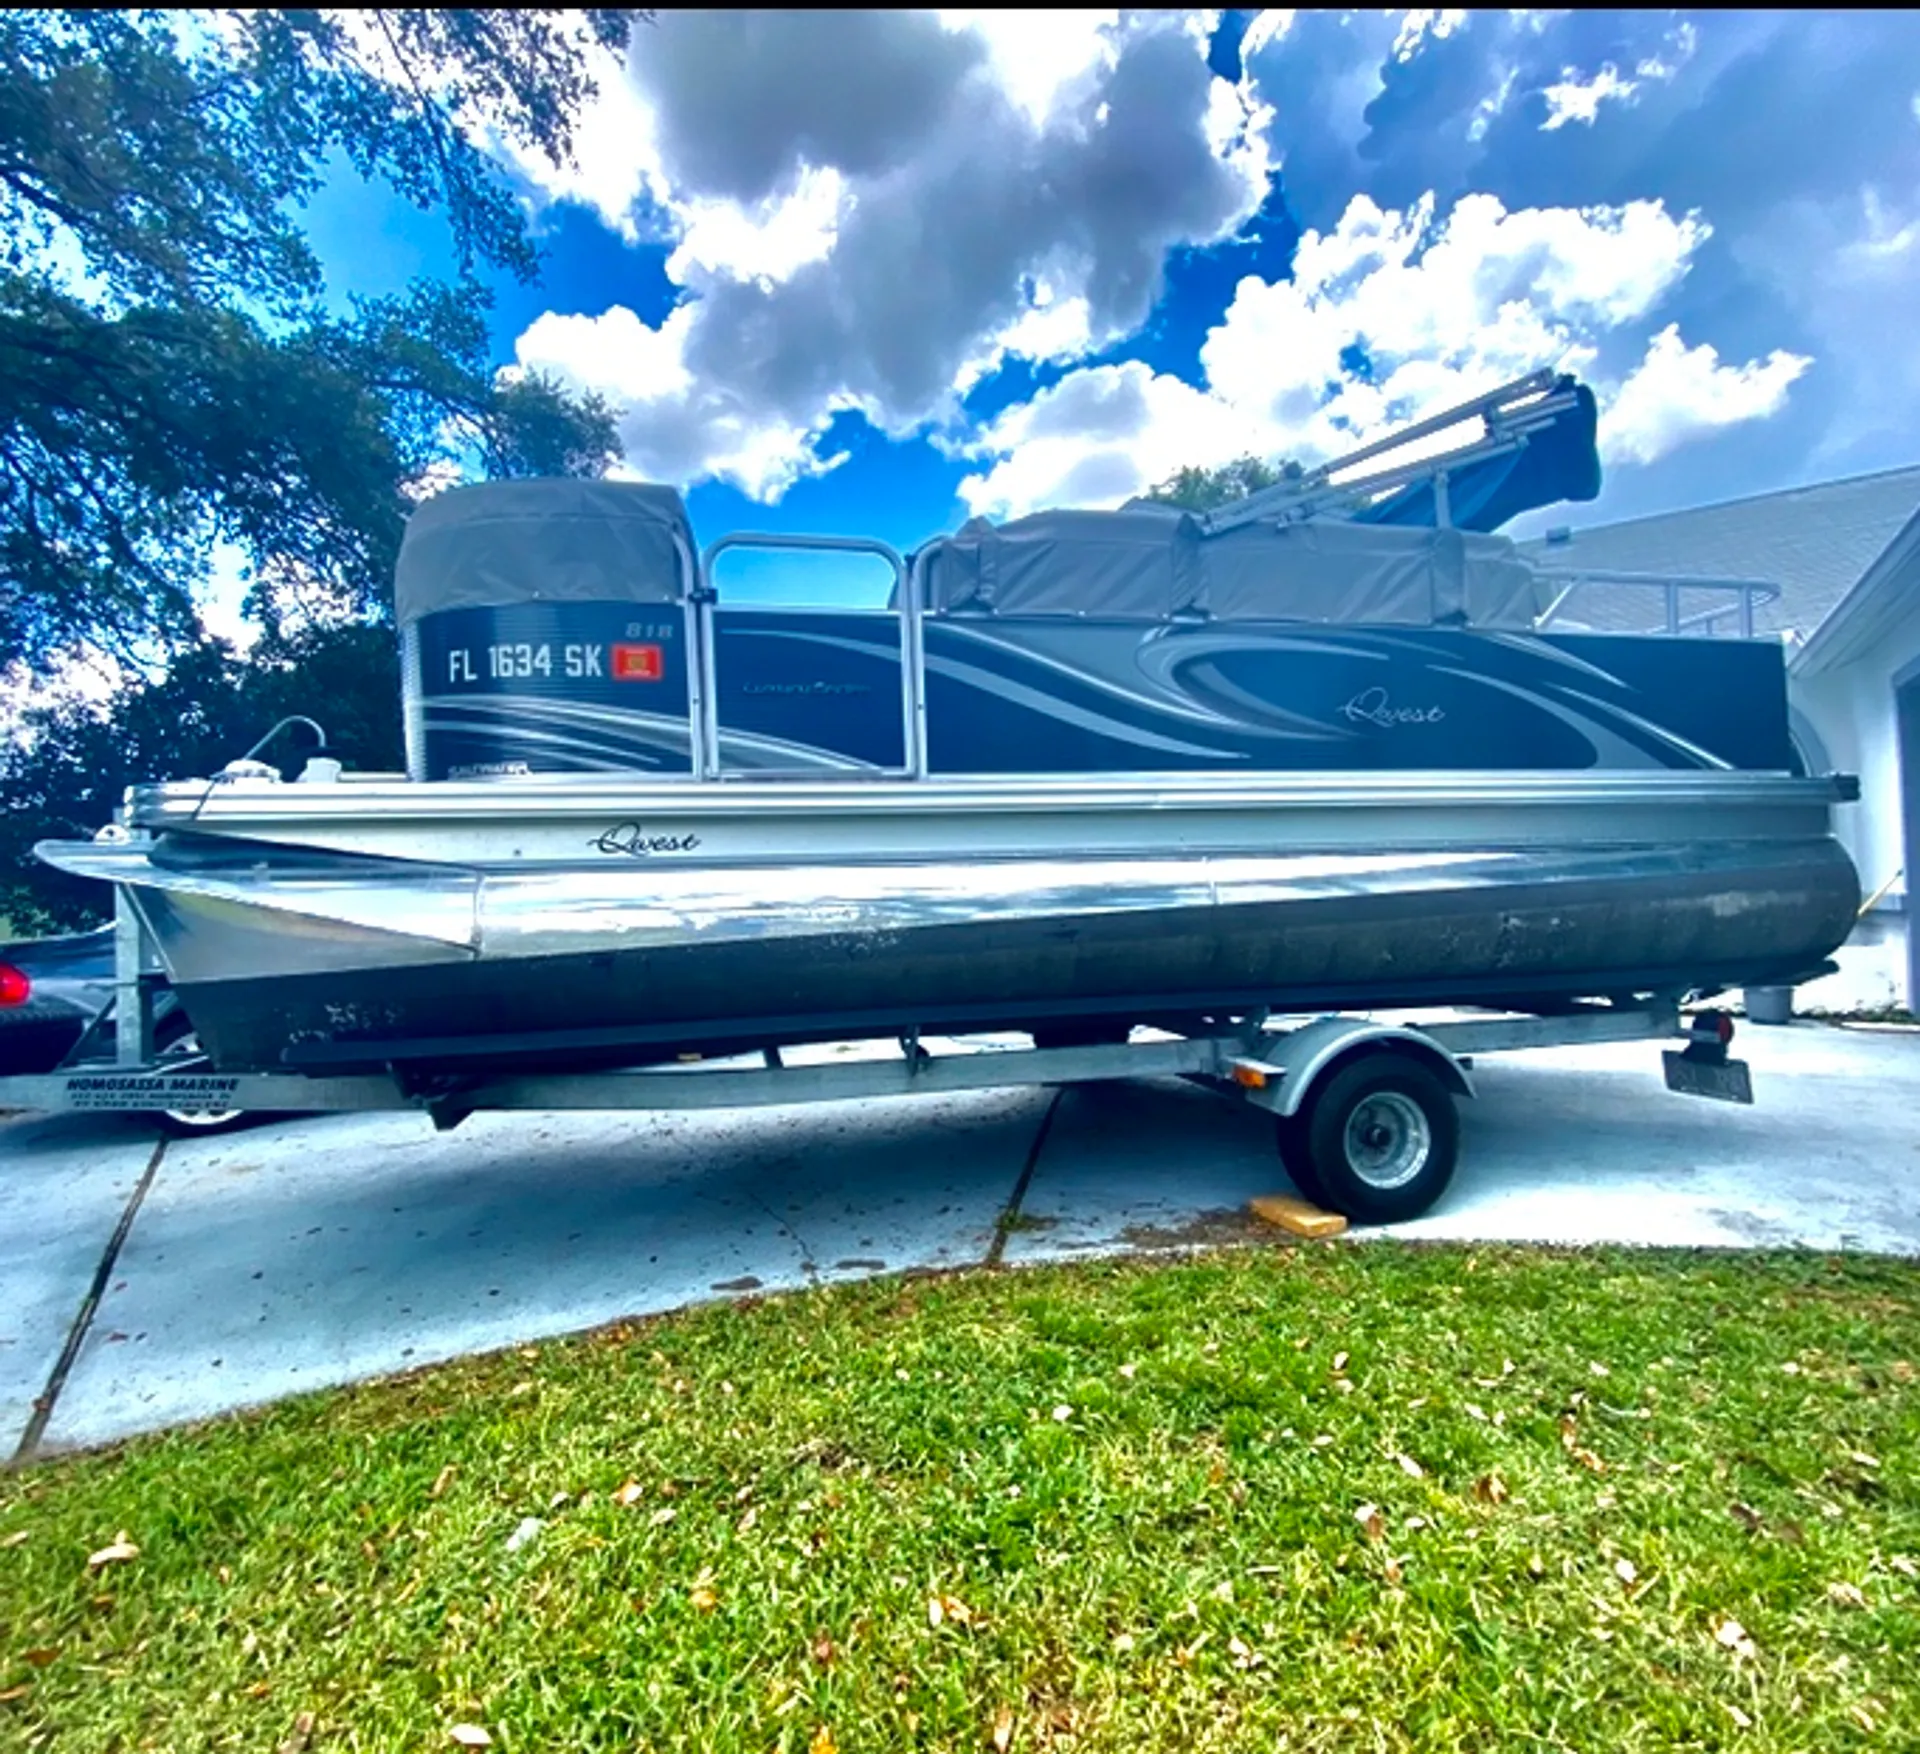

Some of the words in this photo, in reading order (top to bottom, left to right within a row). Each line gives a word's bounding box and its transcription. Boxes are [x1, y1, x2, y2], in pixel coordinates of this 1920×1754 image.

[449, 648, 478, 683] FL
[488, 644, 552, 678] 1634
[565, 643, 603, 677] SK
[586, 820, 702, 857] Qwest
[67, 1078, 165, 1091] HOMOSASSA
[169, 1078, 240, 1091] MARINE
